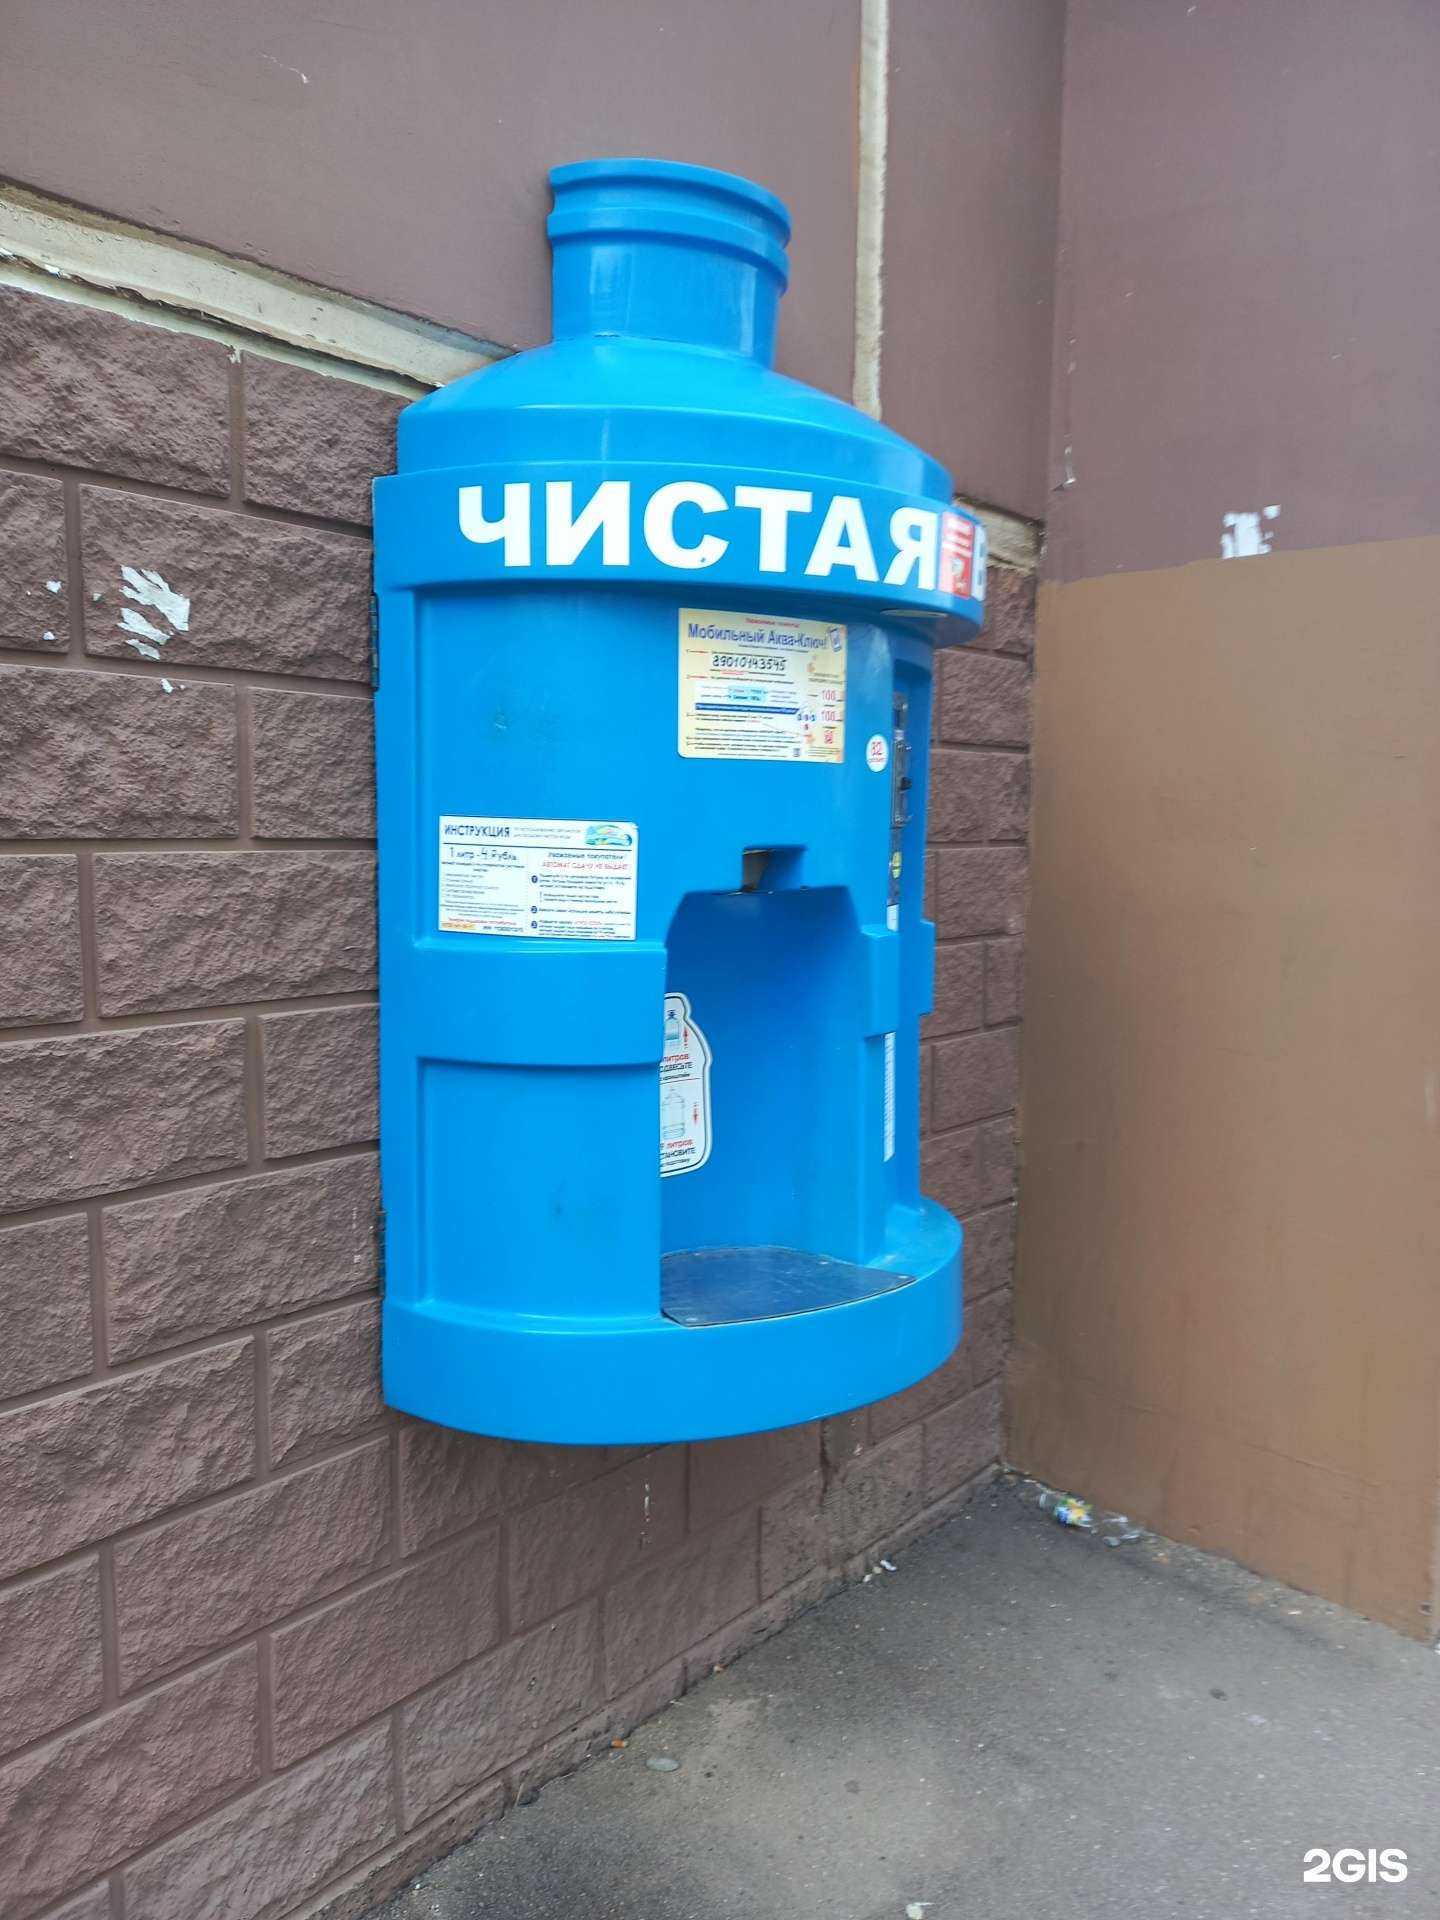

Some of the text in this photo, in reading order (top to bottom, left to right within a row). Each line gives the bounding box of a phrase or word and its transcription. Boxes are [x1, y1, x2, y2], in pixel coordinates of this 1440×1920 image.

[458, 480, 939, 591] ЧИСТАЯ
[688, 623, 765, 643] Мобильный
[444, 824, 511, 838] ИНСТРУКЦИЯ
